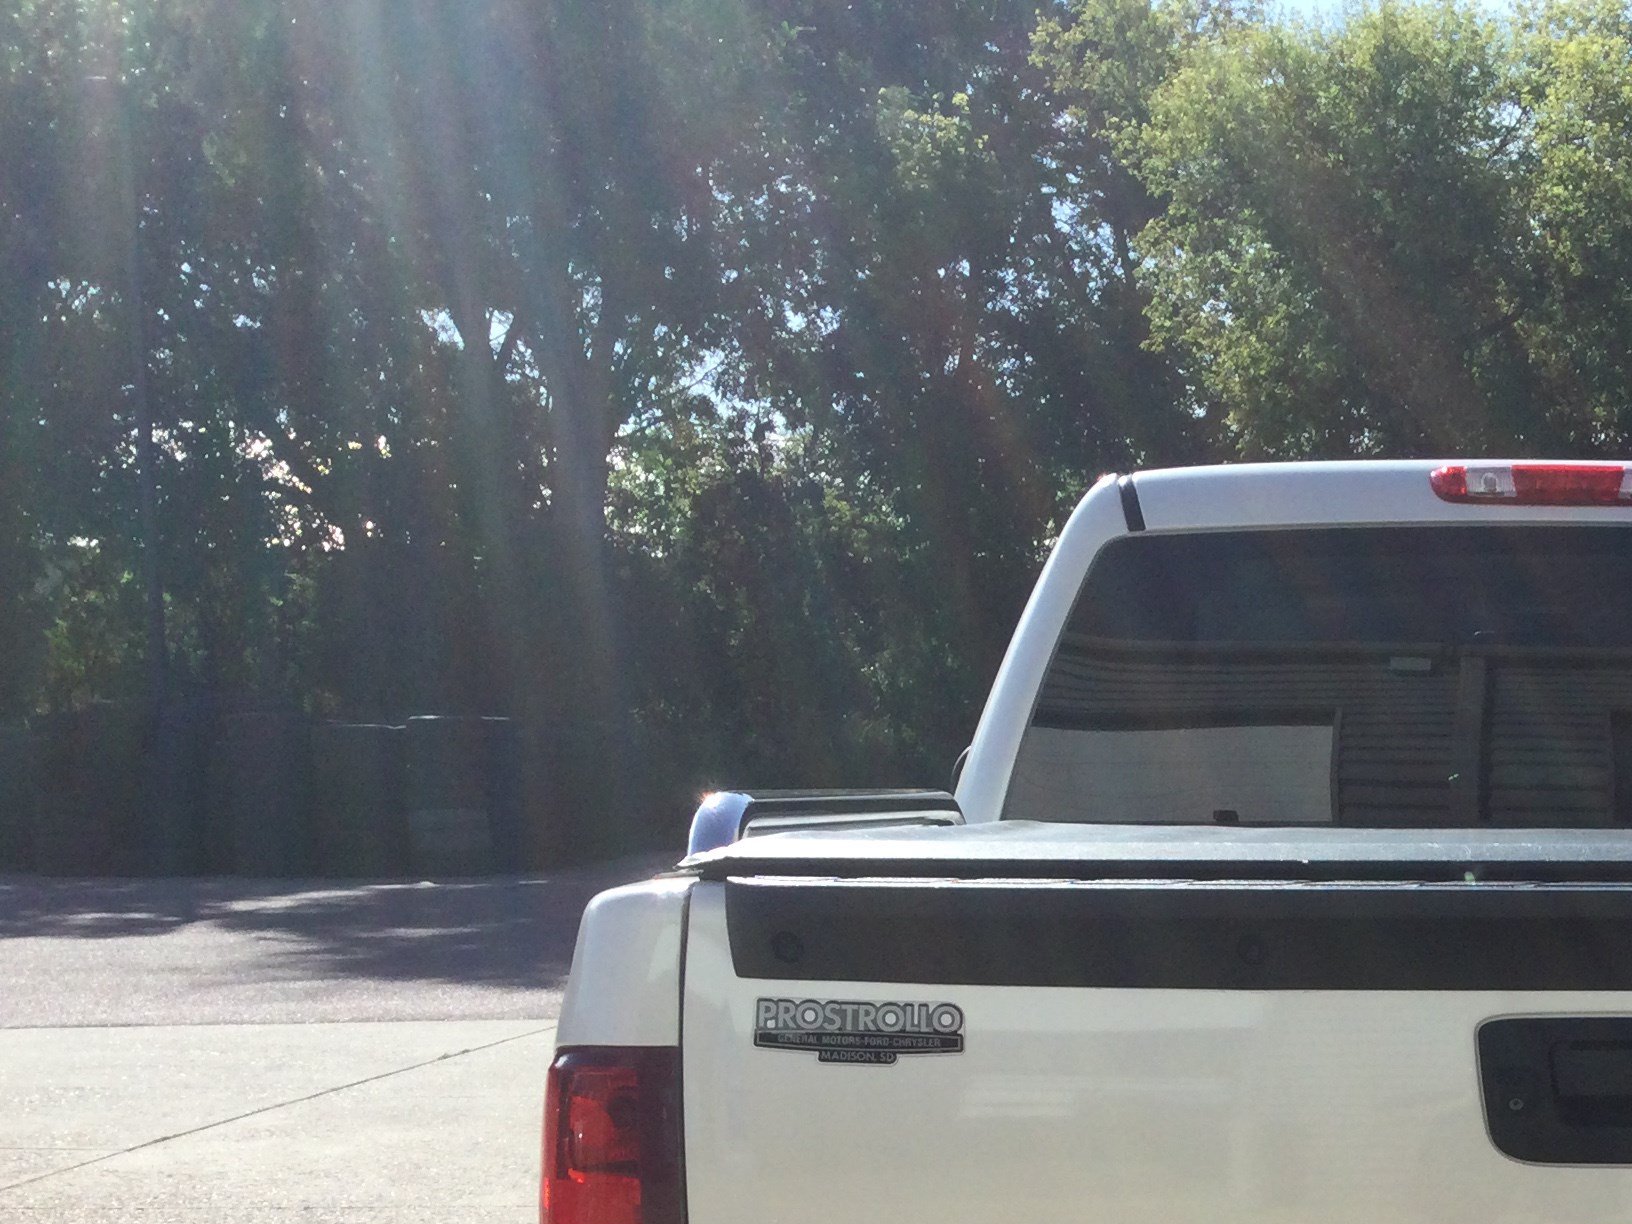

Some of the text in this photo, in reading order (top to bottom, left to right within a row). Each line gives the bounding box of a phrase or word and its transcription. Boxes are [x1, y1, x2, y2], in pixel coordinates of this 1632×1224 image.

[758, 1000, 962, 1034] PROSTROLLO
[778, 1034, 818, 1044] GENERAL
[880, 1051, 895, 1062] SD
